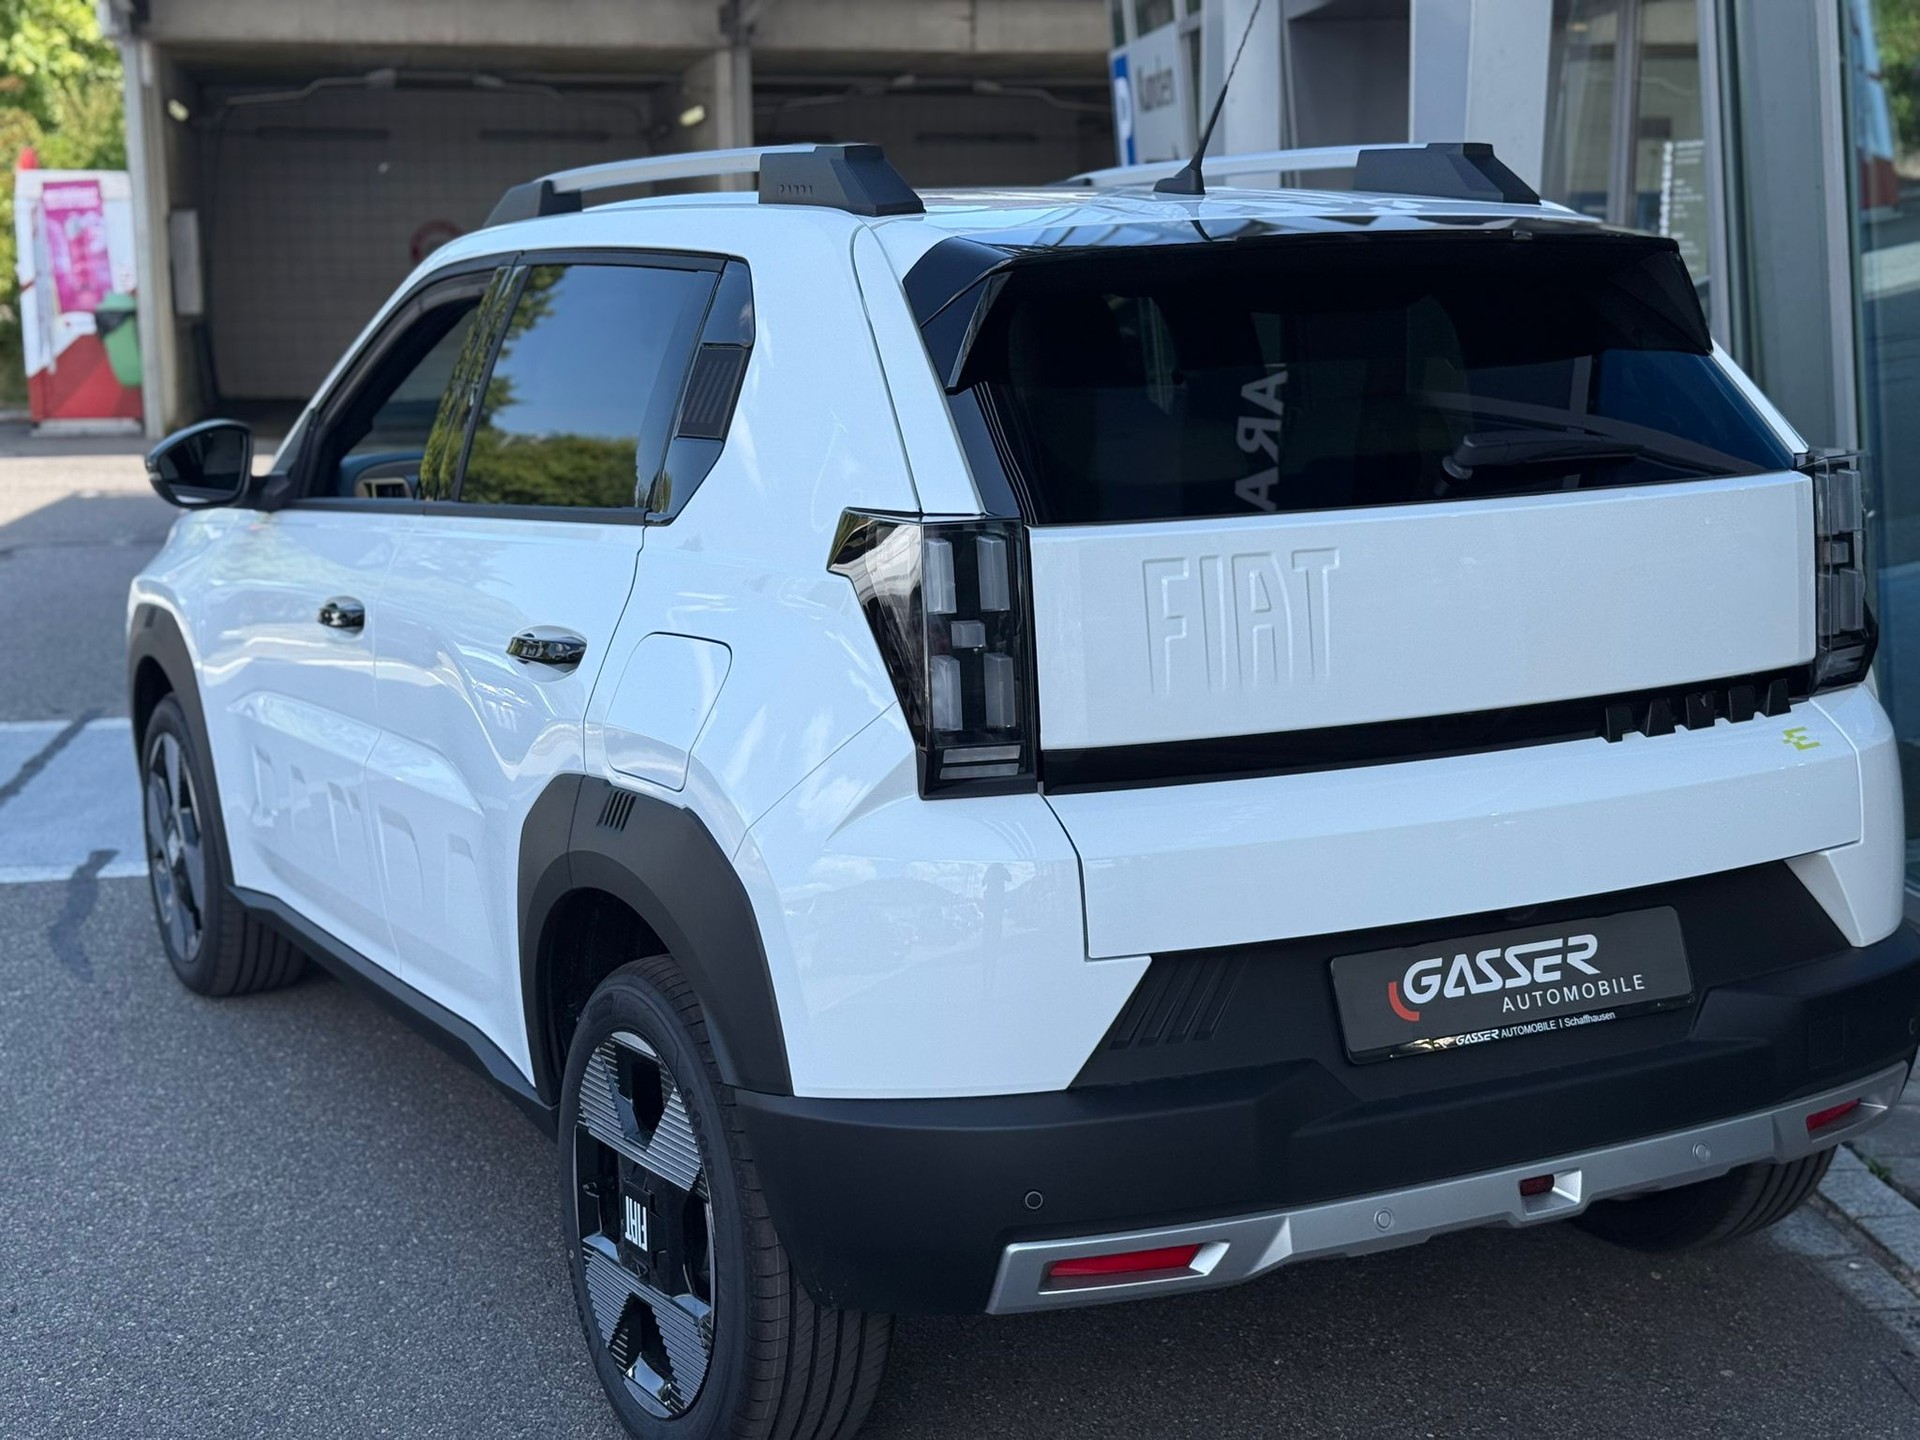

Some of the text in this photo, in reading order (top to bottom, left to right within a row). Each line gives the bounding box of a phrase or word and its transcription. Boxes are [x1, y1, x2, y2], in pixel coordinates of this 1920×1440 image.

[1142, 547, 1340, 697] FIAT
[1402, 933, 1601, 1004] GASSER
[1502, 974, 1645, 1013] AUTOMOBILE
[1455, 1029, 1500, 1046] GASSER
[1501, 1020, 1557, 1039] AUTOMOBILE
[1564, 1011, 1616, 1027] Schaffhausen
[624, 1195, 648, 1252] FIAT
